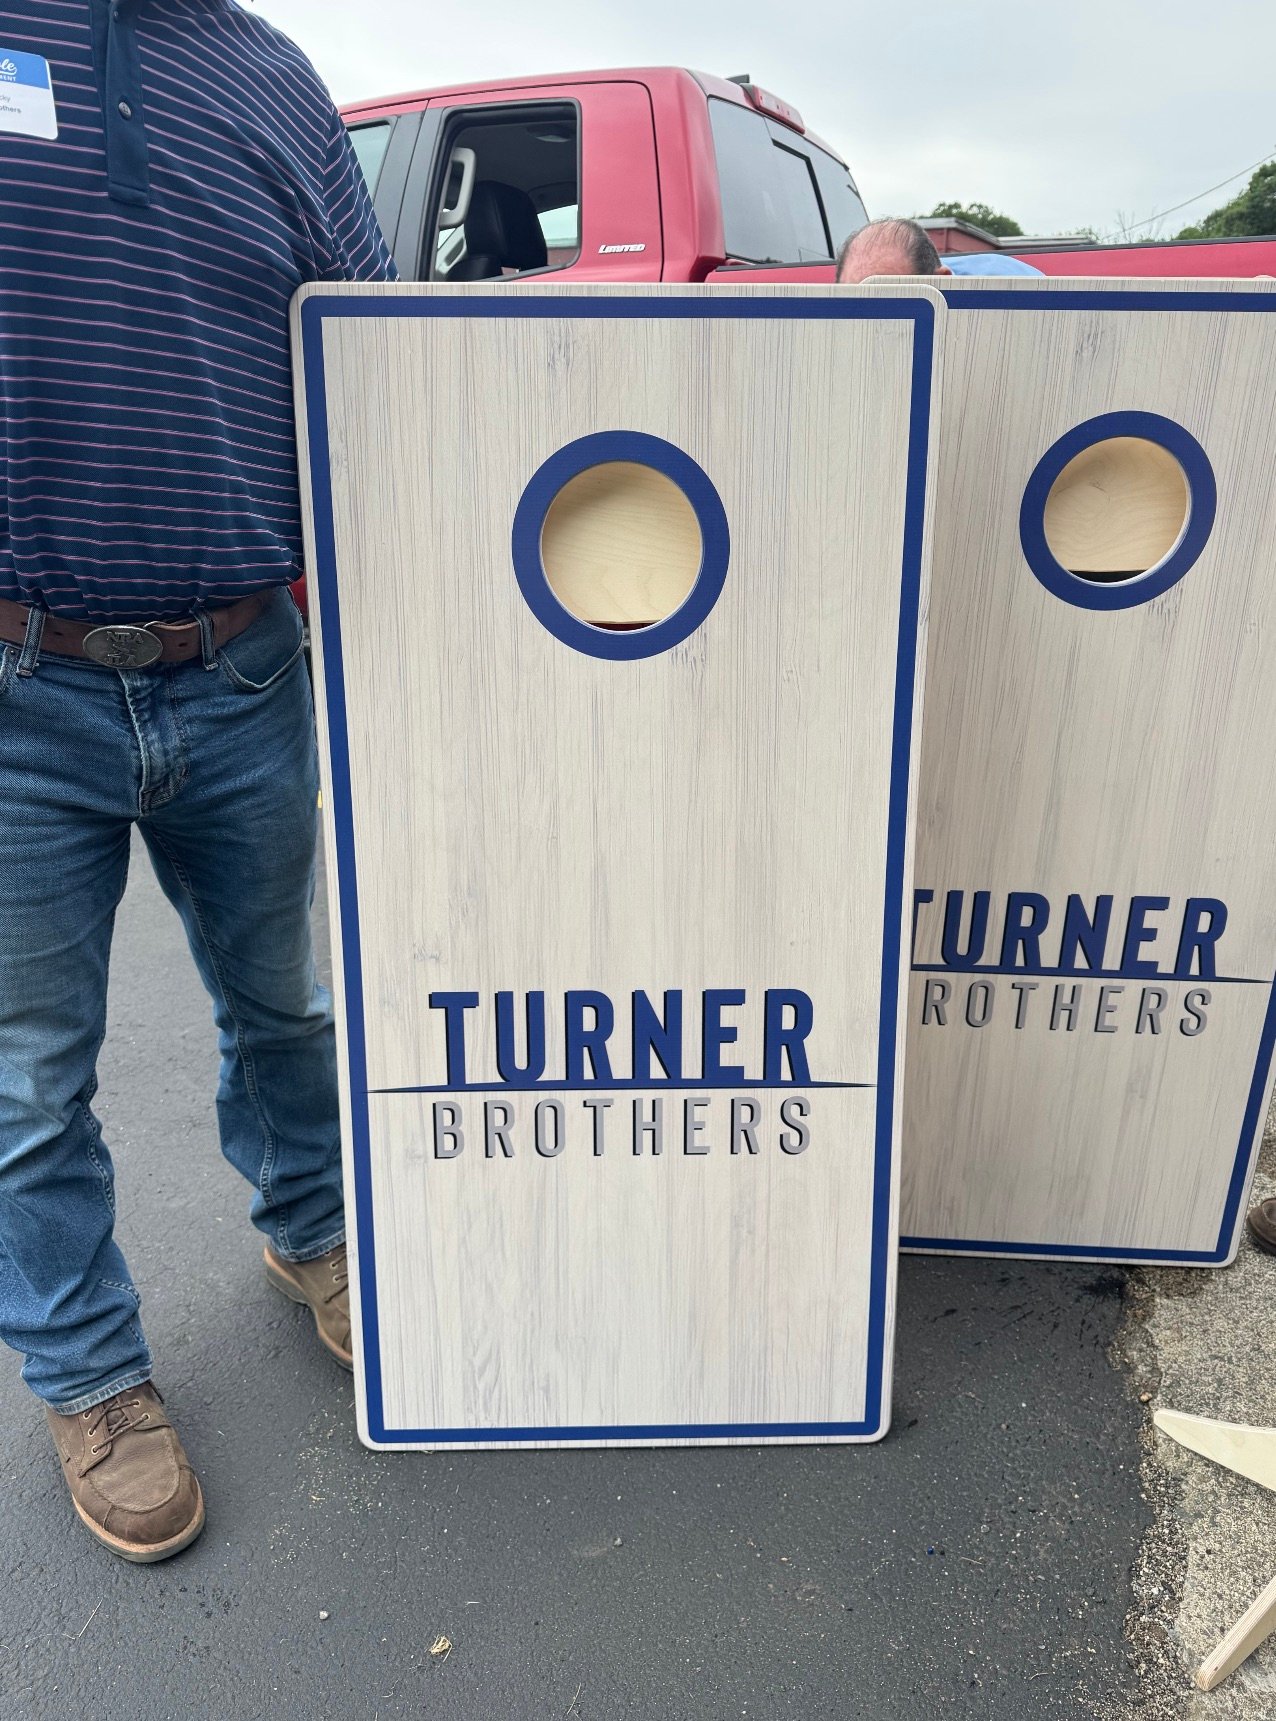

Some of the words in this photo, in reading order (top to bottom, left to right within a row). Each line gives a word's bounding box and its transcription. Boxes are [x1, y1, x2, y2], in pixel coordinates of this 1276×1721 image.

[428, 988, 814, 1086] TURNER
[921, 978, 1213, 1037] ROTHERS
[433, 1095, 812, 1159] BROTHERS
